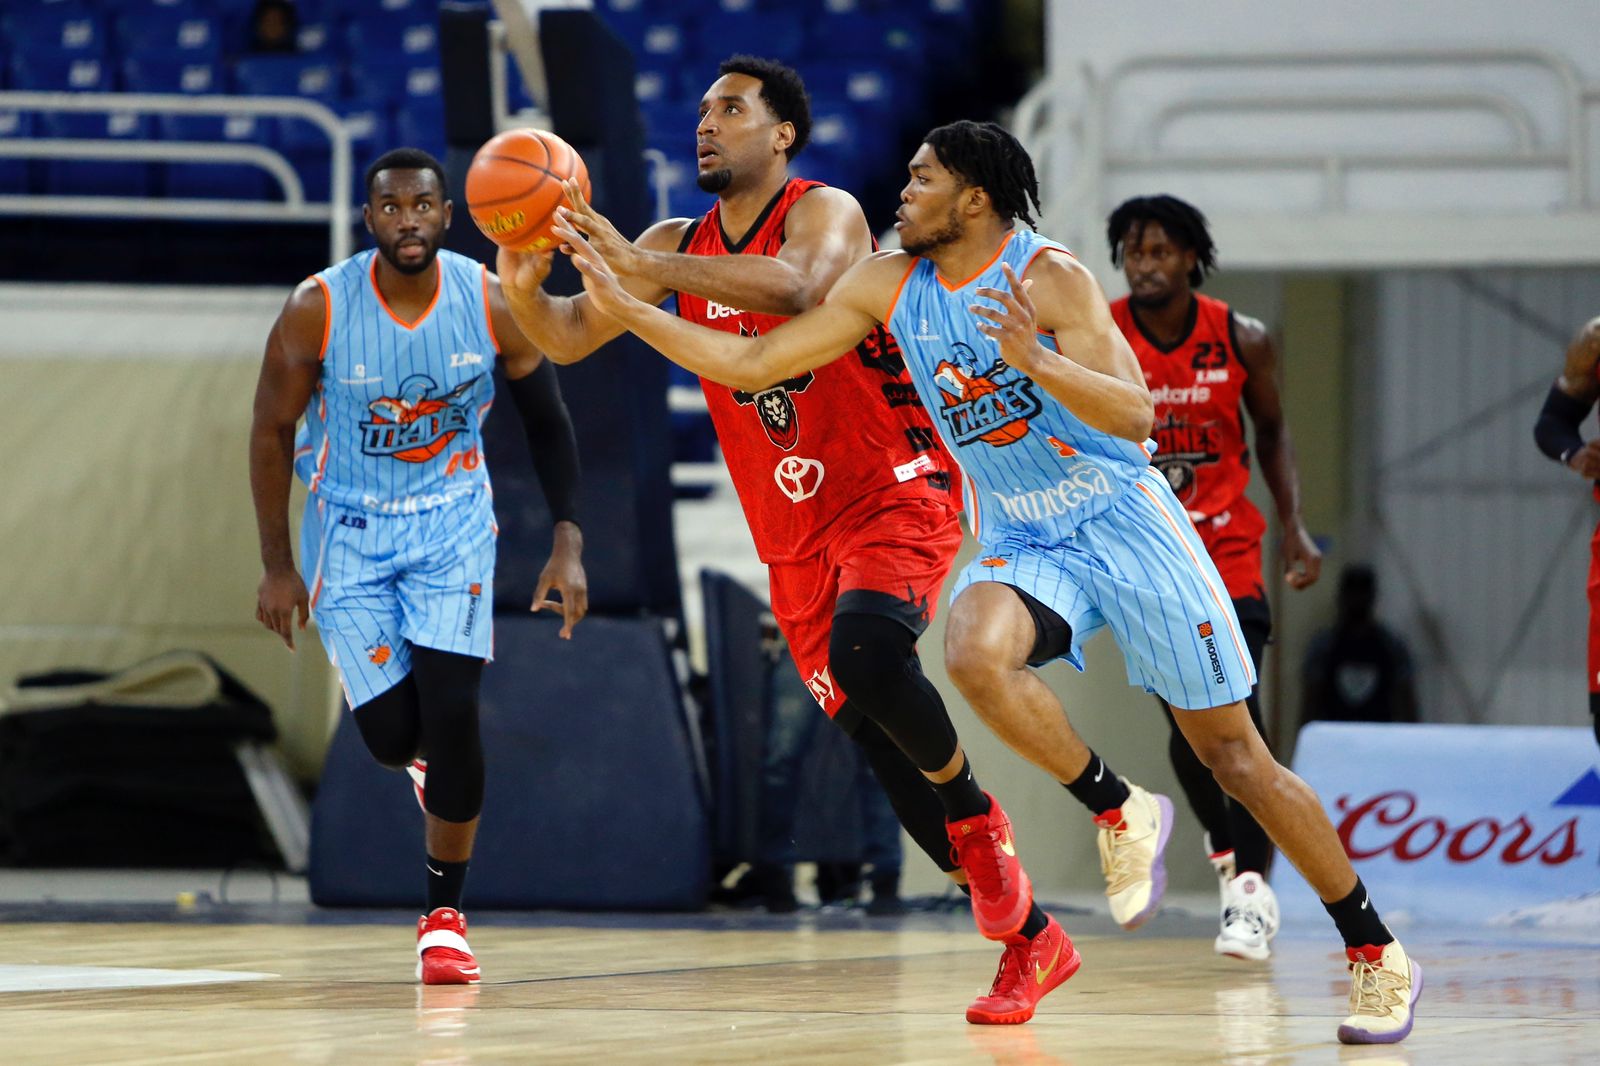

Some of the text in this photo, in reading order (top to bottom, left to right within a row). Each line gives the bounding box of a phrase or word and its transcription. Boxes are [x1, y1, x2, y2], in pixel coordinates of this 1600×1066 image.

[1192, 341, 1228, 370] 23
[940, 376, 1043, 446] TITANES
[1149, 384, 1211, 406] etcris
[1153, 424, 1222, 456] ONES
[1204, 637, 1226, 685] MODESTO
[1335, 790, 1584, 866] Coors
